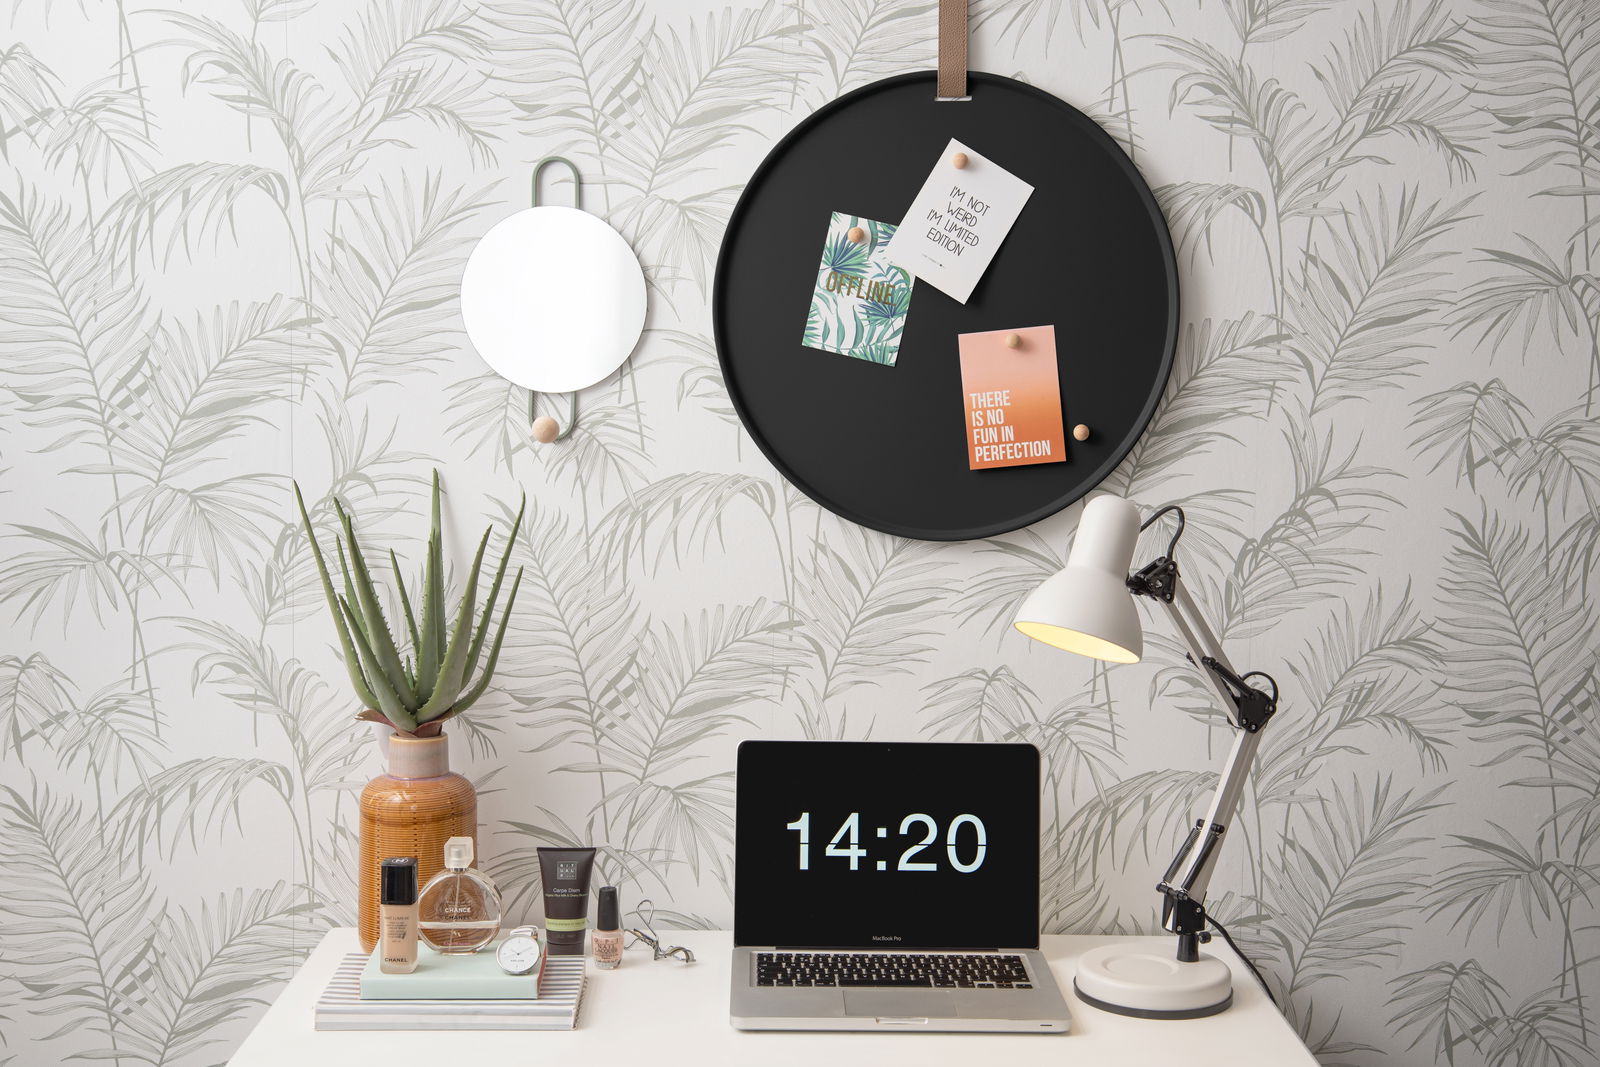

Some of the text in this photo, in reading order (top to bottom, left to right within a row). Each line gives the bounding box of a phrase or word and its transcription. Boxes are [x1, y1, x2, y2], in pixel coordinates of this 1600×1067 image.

[947, 201, 978, 227] WEIRD
[949, 185, 991, 217] I'M NOT
[926, 208, 980, 247] I'M LIMITED
[926, 227, 965, 256] EDITION
[826, 271, 897, 306] OFFLINE
[969, 390, 1011, 409] THERE
[972, 408, 1005, 427] IS NO
[973, 425, 1015, 445] FUN IN
[975, 440, 1051, 463] PERFECTION
[787, 812, 986, 874] 14:20
